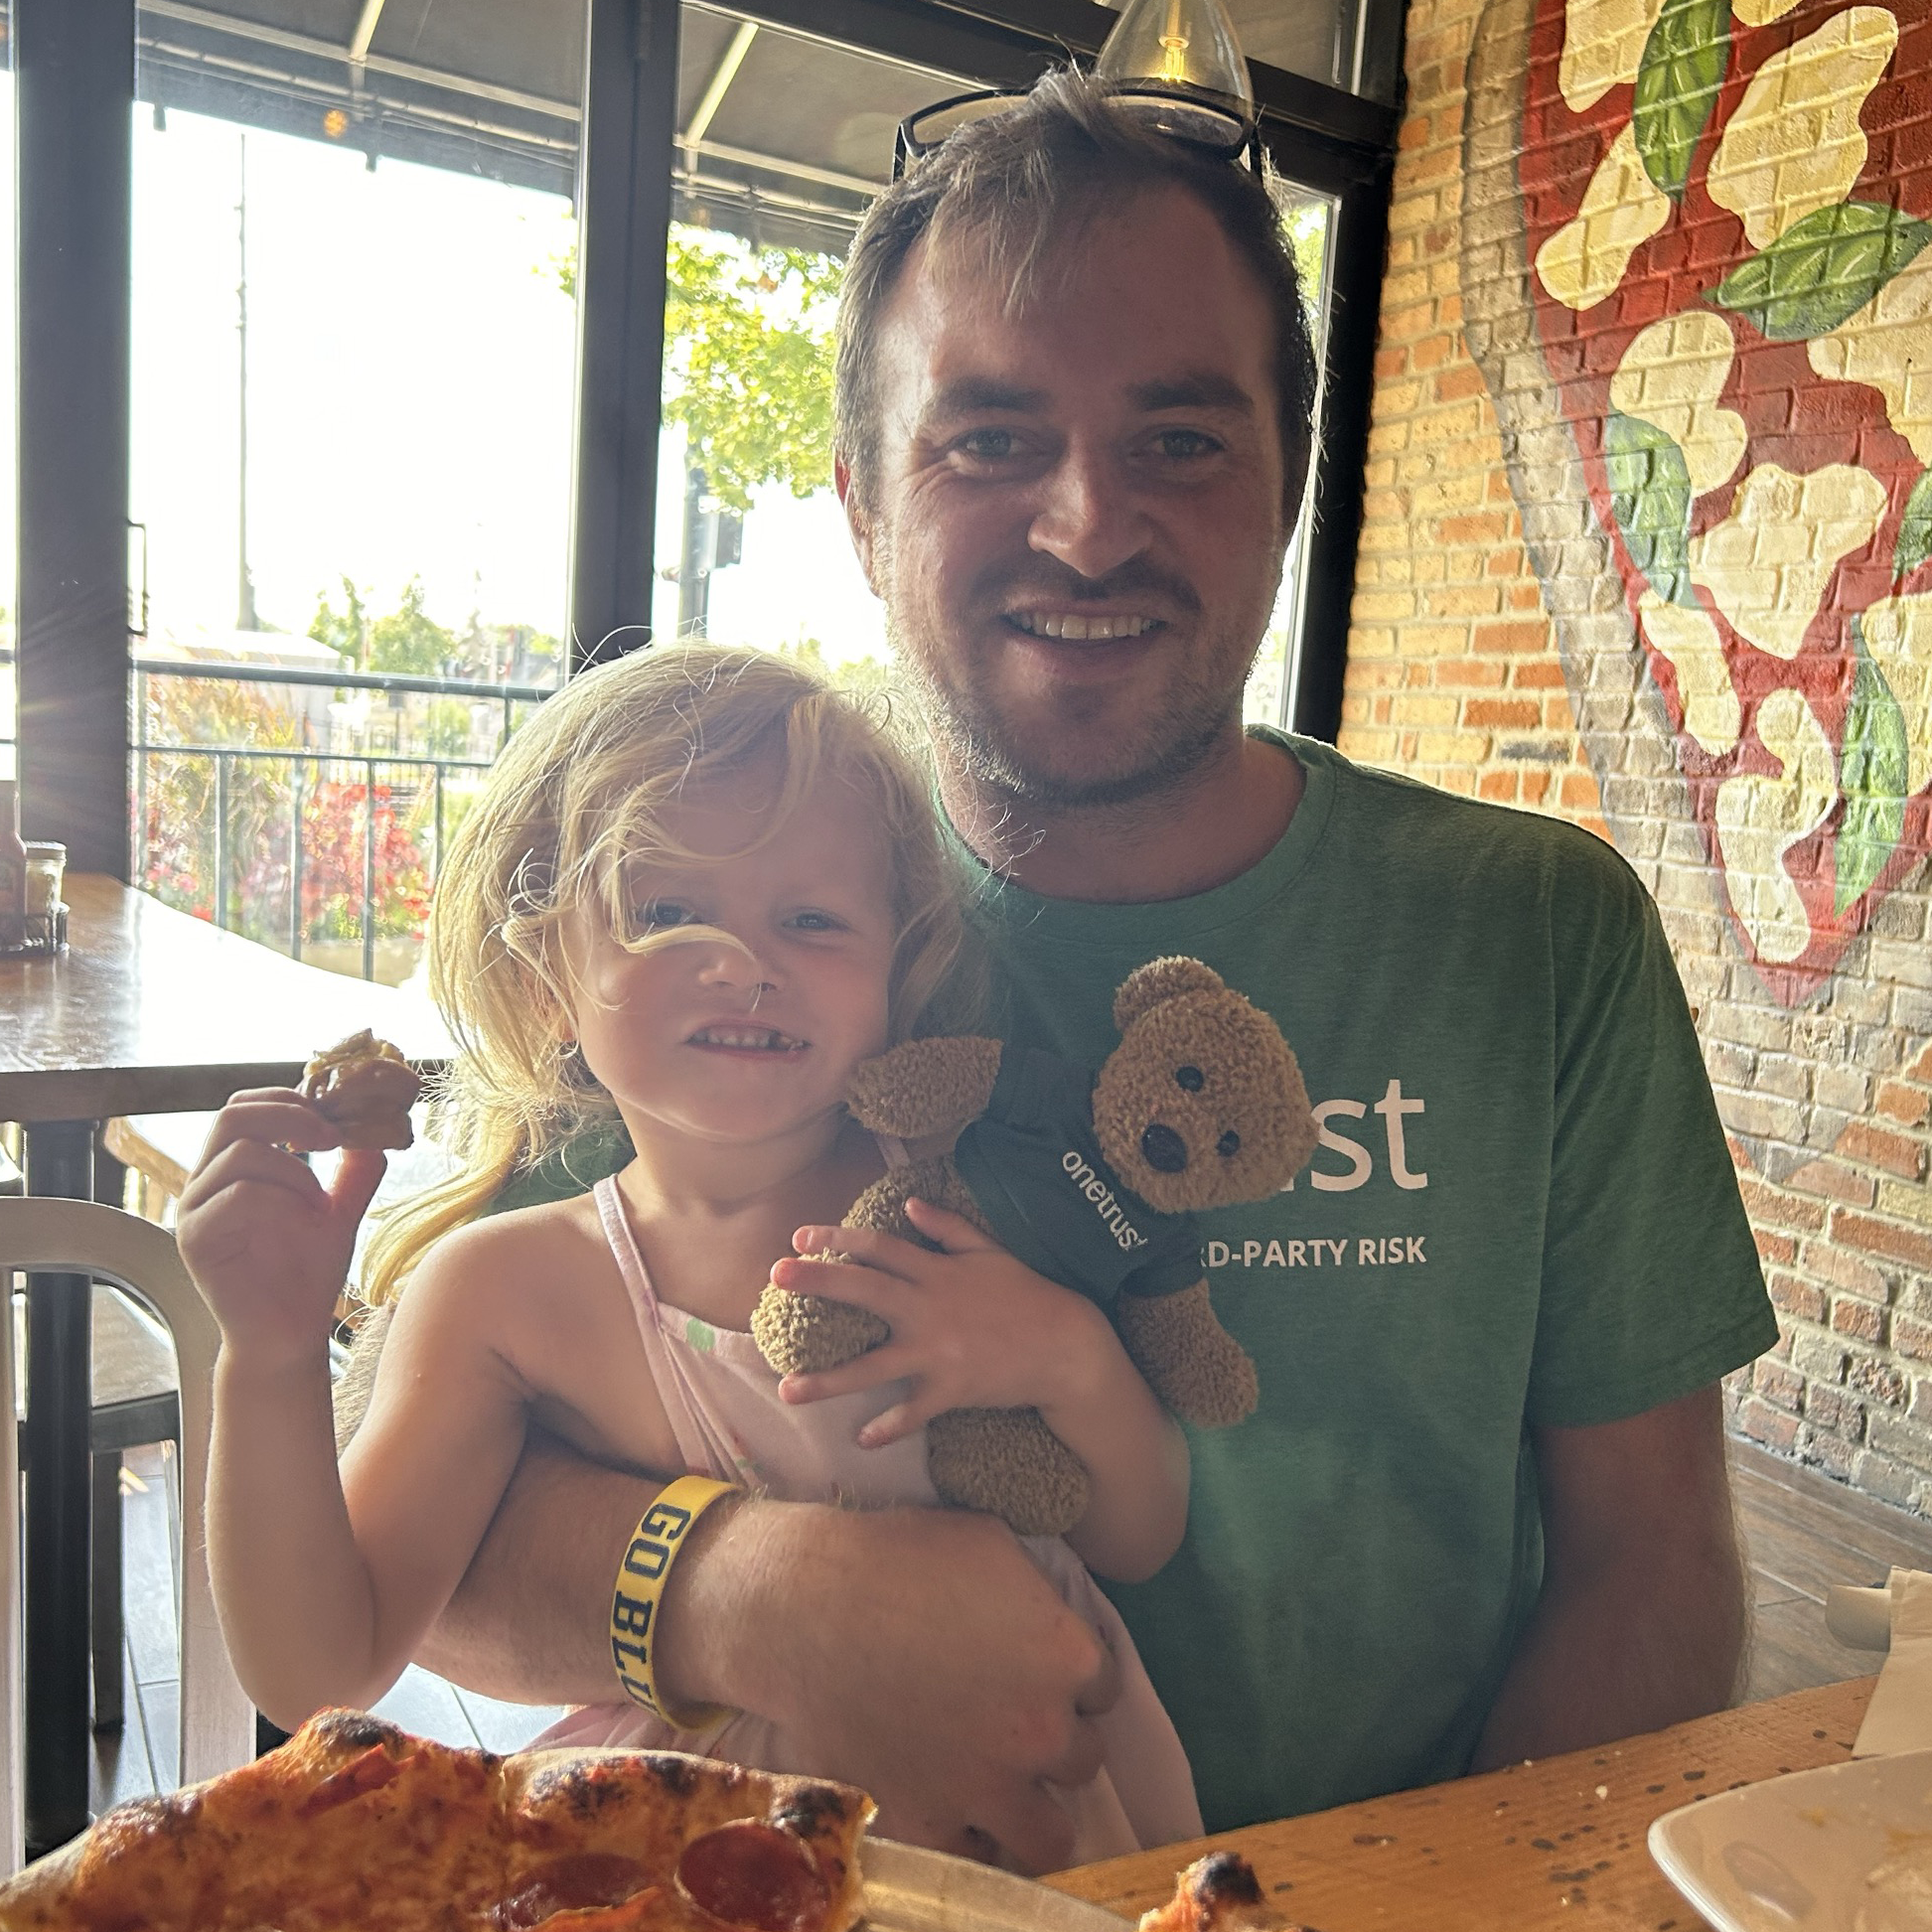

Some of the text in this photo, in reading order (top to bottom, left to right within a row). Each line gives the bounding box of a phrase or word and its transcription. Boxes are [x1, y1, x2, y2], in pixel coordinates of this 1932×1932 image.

[1280, 1079, 1428, 1192] st
[1358, 1236, 1428, 1266] RISK
[624, 1503, 691, 1580] GO
